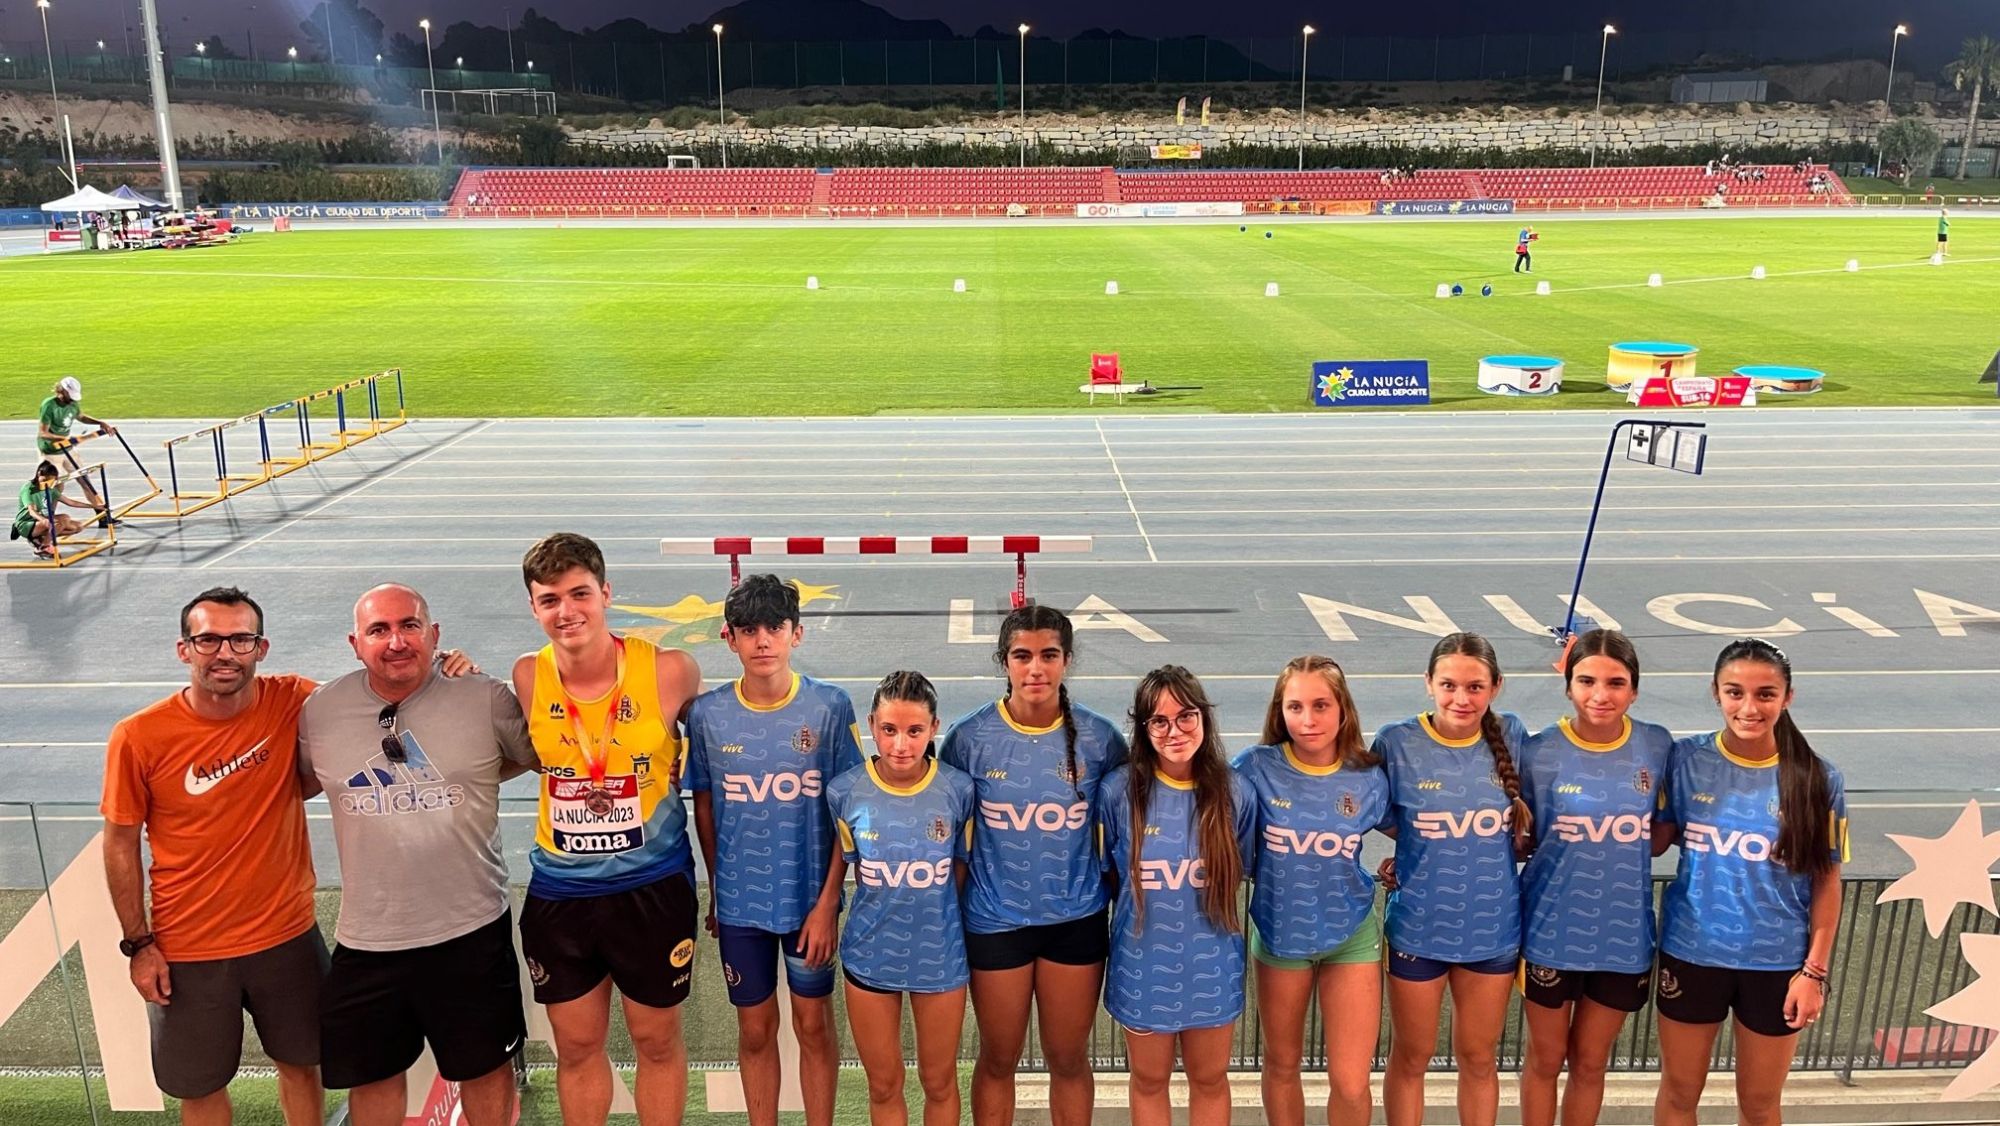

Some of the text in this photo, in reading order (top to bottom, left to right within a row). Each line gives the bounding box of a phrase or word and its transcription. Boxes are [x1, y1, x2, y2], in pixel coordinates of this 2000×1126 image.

[325, 208, 360, 216] CIUDAD
[362, 208, 378, 216] DEL
[380, 207, 421, 216] DEPORTE
[1528, 372, 1542, 389] 2
[1660, 361, 1673, 377] 1
[1347, 388, 1427, 397] CIUDAD DEL DEPORTE
[1354, 377, 1370, 387] LA
[947, 594, 1168, 643] LA
[194, 746, 271, 785] Athlete
[578, 779, 626, 791] REA
[722, 769, 822, 803] EVOS
[338, 782, 465, 816] adidas
[554, 806, 564, 824] LA
[608, 806, 634, 823] 2023
[980, 799, 1088, 832] EVOS
[1262, 824, 1360, 859] EVOS
[859, 857, 951, 889] EVOS
